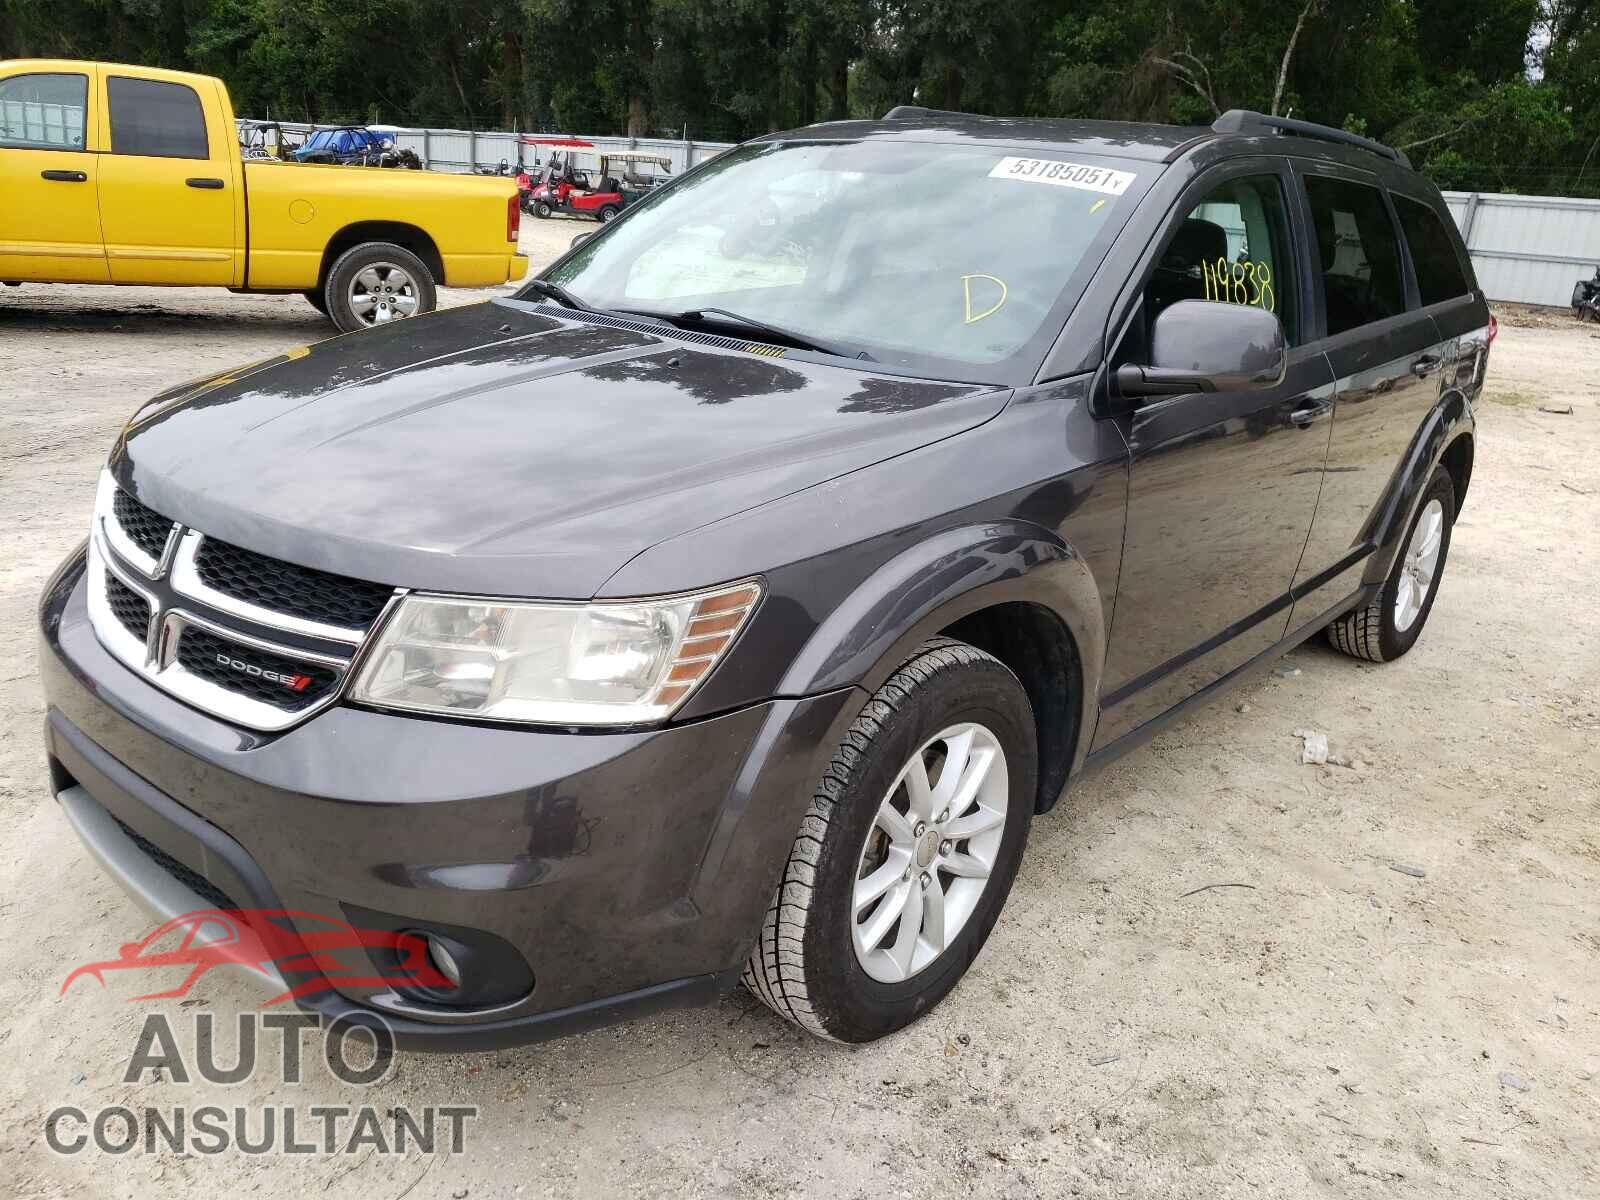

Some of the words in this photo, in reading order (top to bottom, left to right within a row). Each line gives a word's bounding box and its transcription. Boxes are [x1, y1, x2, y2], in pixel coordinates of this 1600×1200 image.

[960, 274, 1007, 324] D
[1202, 257, 1275, 312] 119838
[216, 653, 296, 687] DODGE
